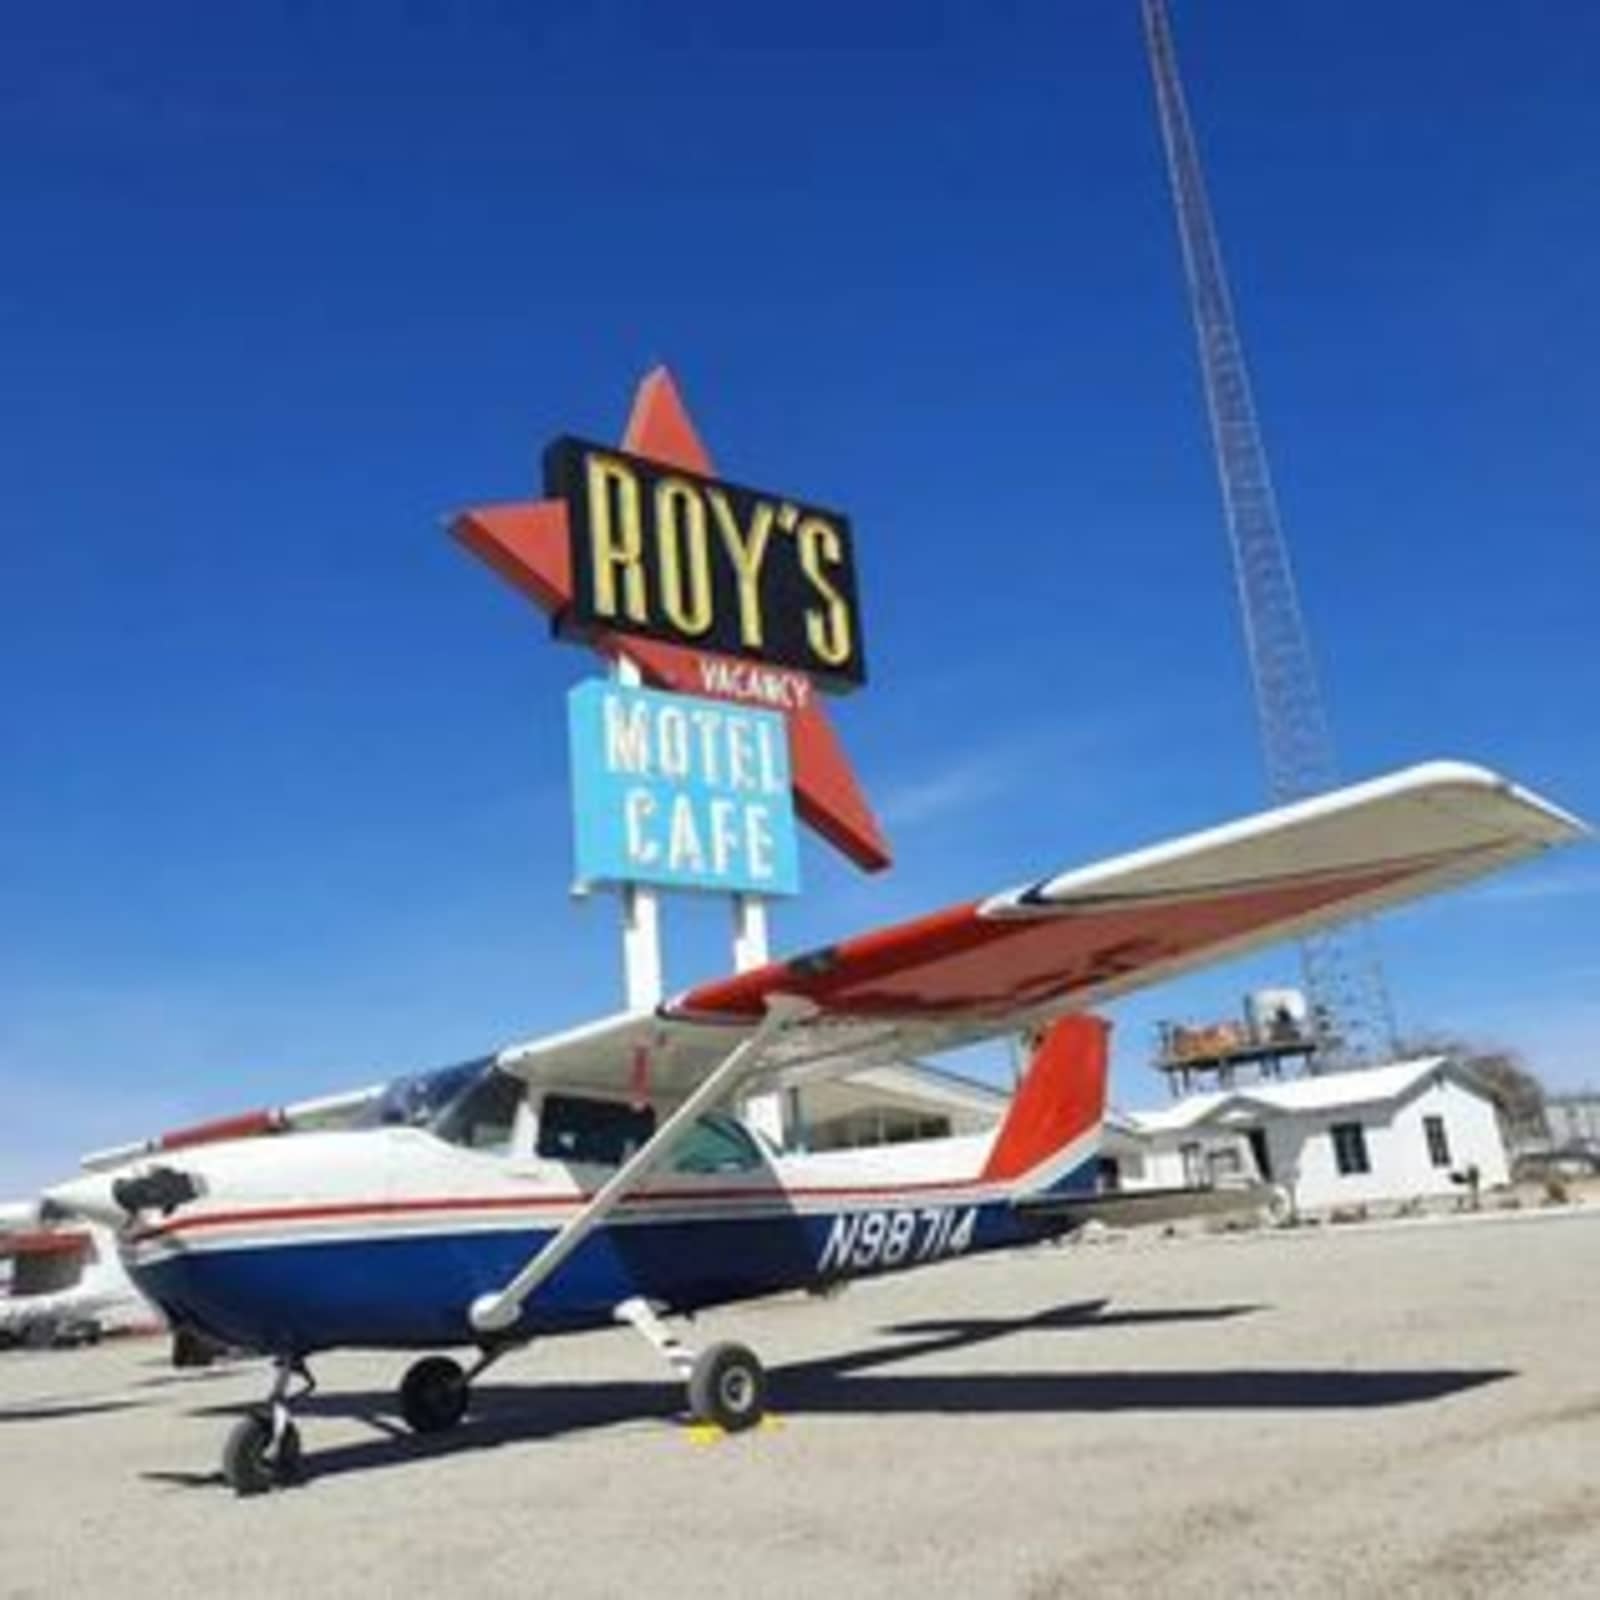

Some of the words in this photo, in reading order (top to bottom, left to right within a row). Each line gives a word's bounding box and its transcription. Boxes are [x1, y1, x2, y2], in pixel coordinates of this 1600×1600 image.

[585, 453, 852, 665] ROY'S
[699, 658, 813, 709] VACANCY
[602, 694, 786, 794] MOTEL
[624, 787, 775, 882] CAFE
[817, 1206, 977, 1274] N98714
